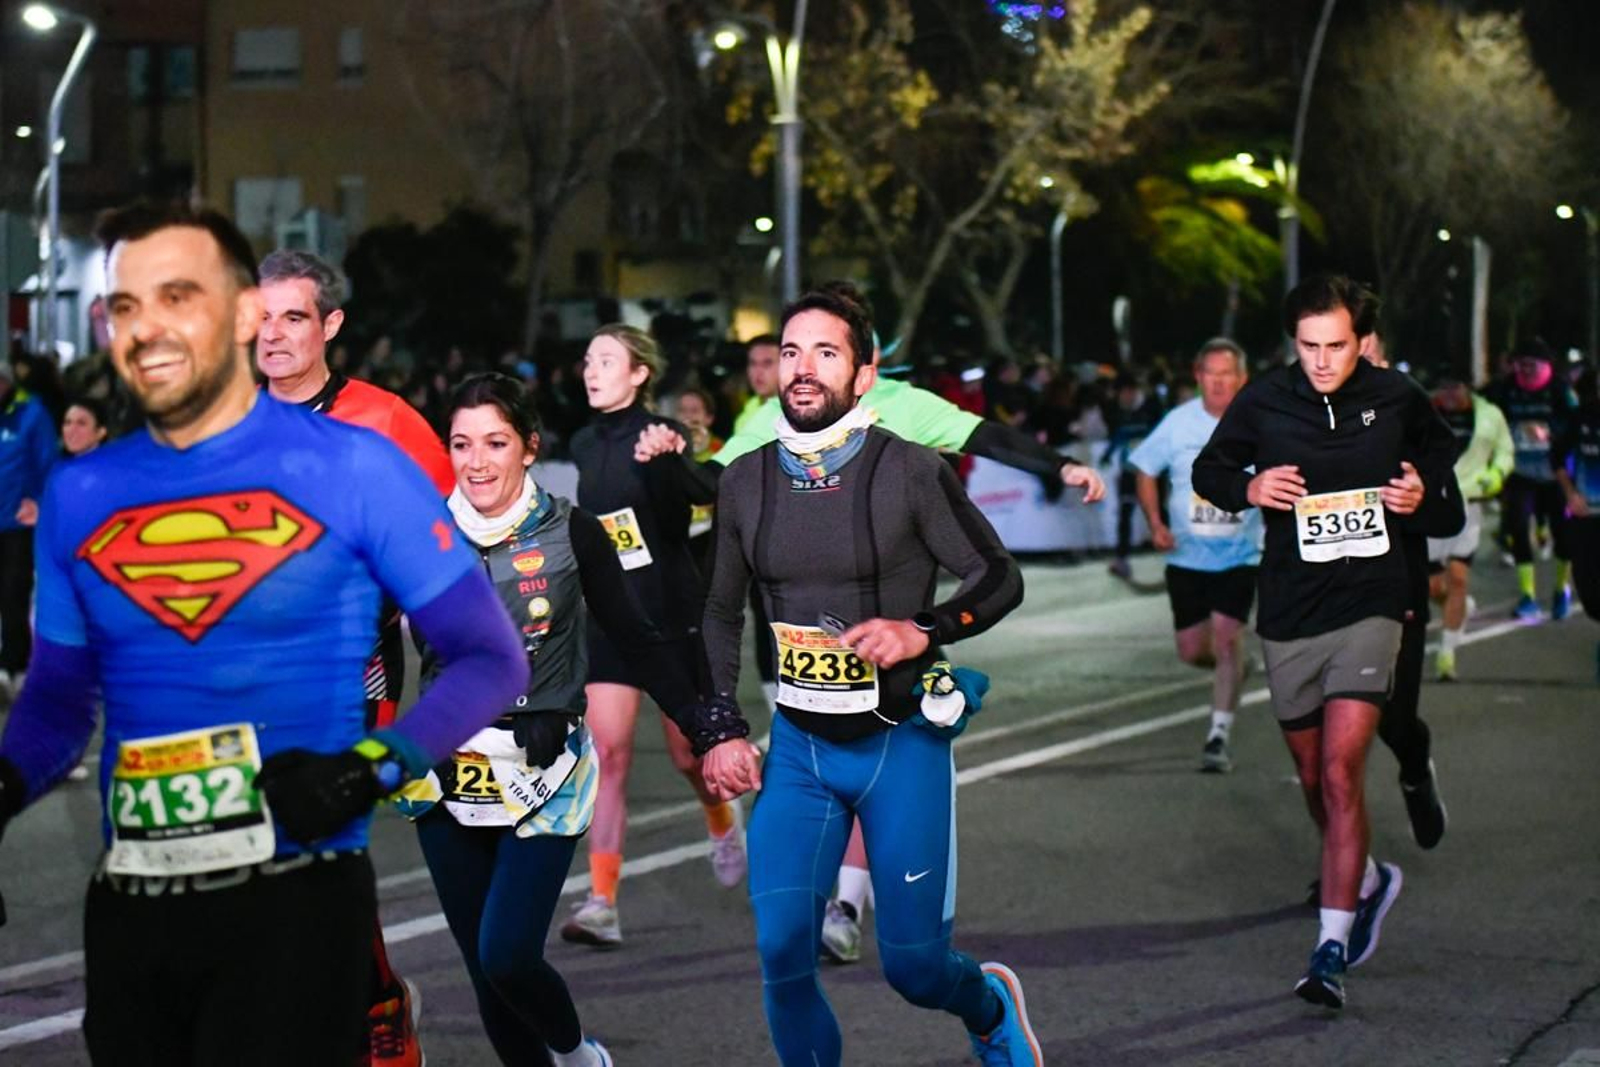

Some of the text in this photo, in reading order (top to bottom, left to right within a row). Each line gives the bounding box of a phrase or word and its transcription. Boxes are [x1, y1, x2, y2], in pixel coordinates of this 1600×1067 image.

[1307, 508, 1377, 537] 5362
[518, 577, 548, 595] RIU
[783, 648, 867, 682] 4238
[117, 765, 251, 828] 2132
[509, 780, 538, 810] TRAI
